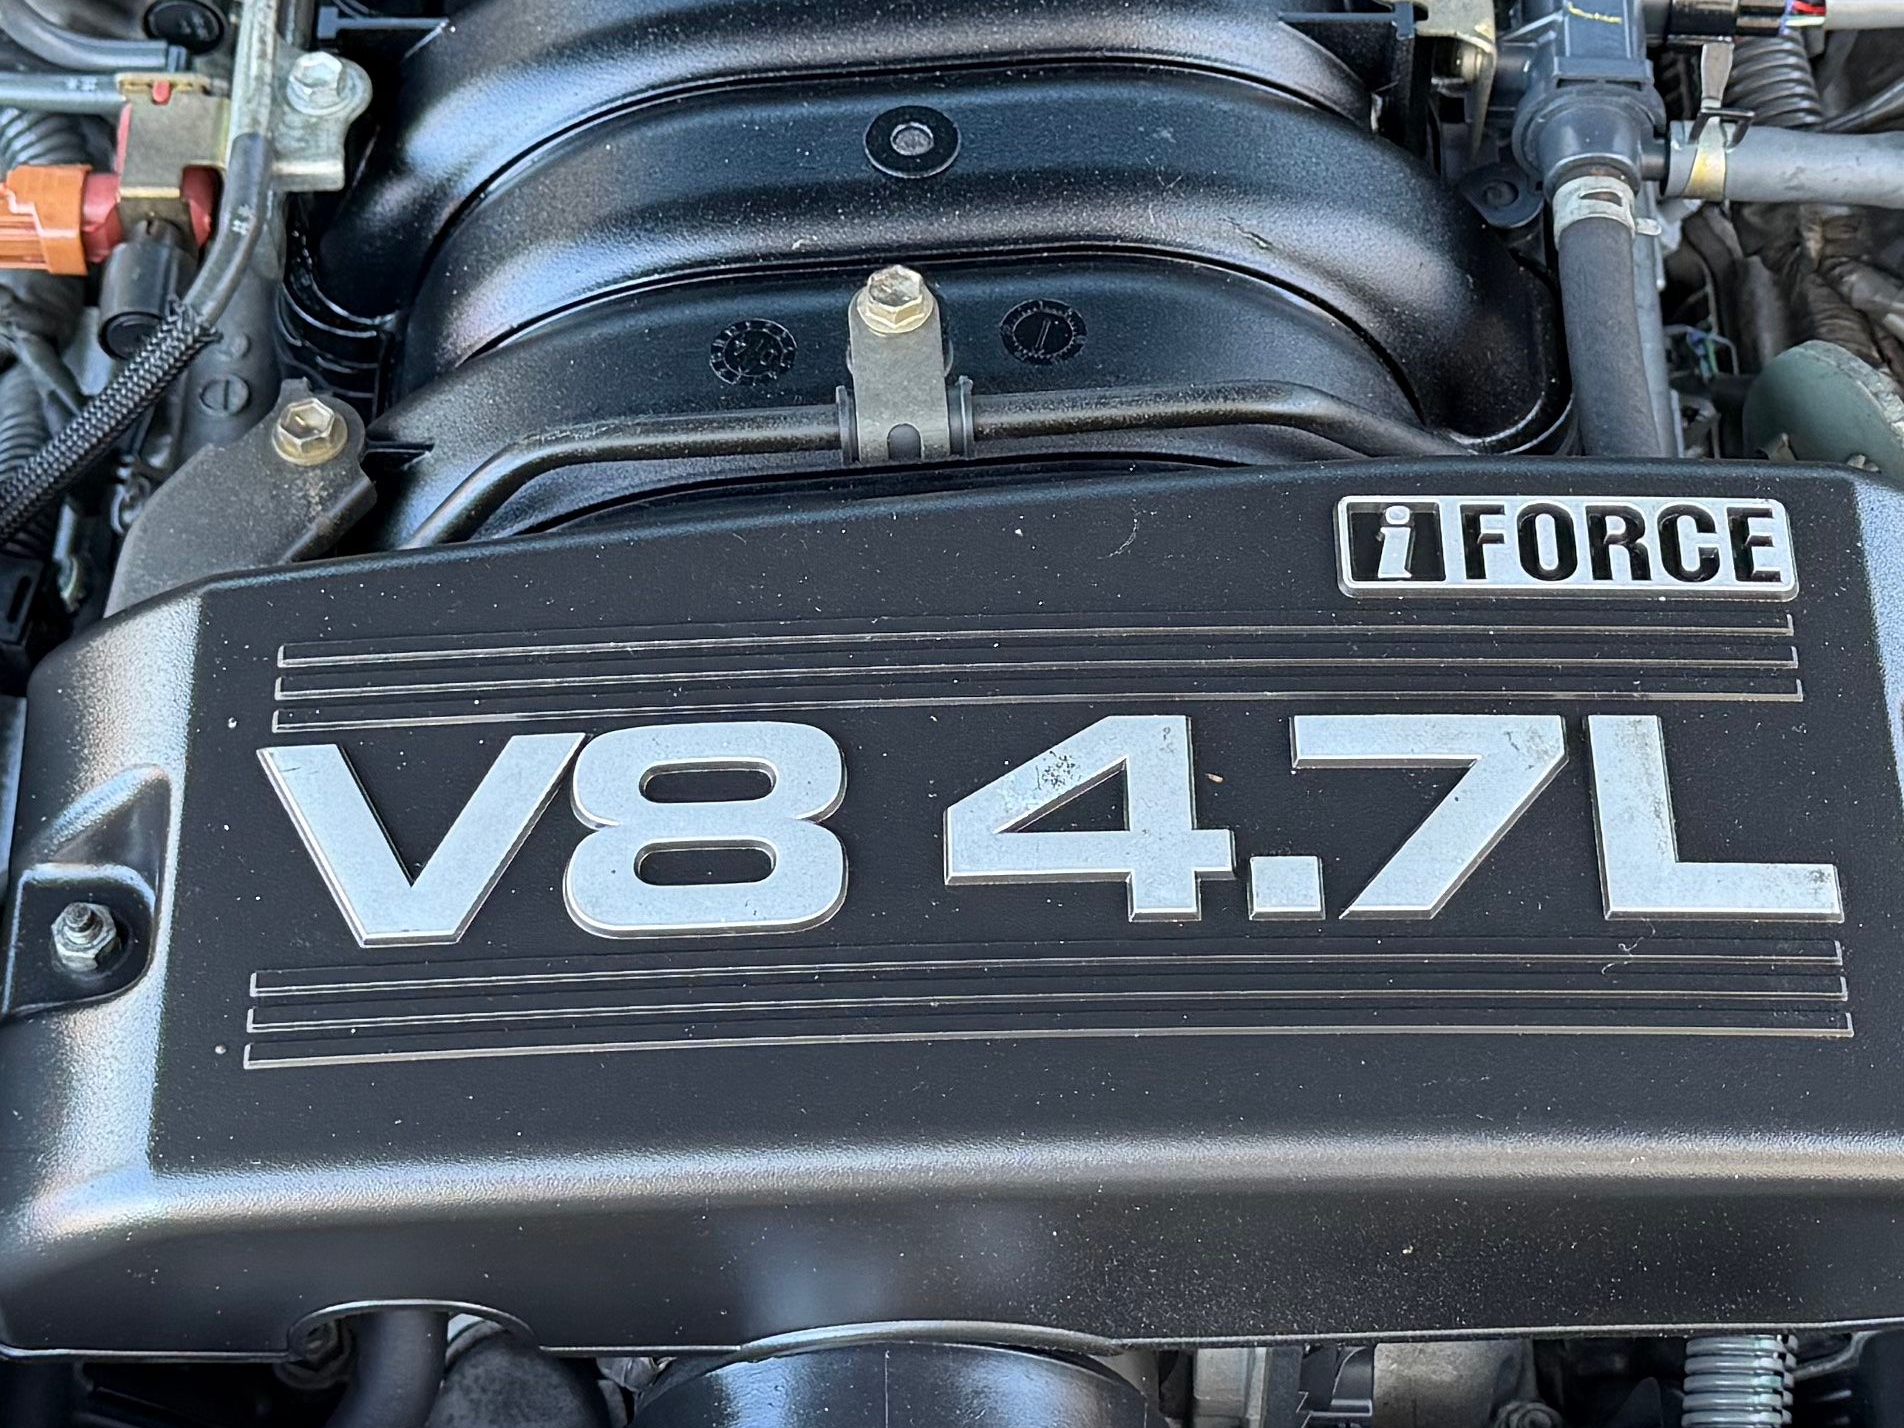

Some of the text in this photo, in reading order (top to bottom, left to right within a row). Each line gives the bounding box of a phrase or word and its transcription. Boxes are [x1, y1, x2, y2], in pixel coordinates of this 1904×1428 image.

[1457, 503, 1784, 583] FORCE
[256, 713, 1845, 948] V8 4.7L
